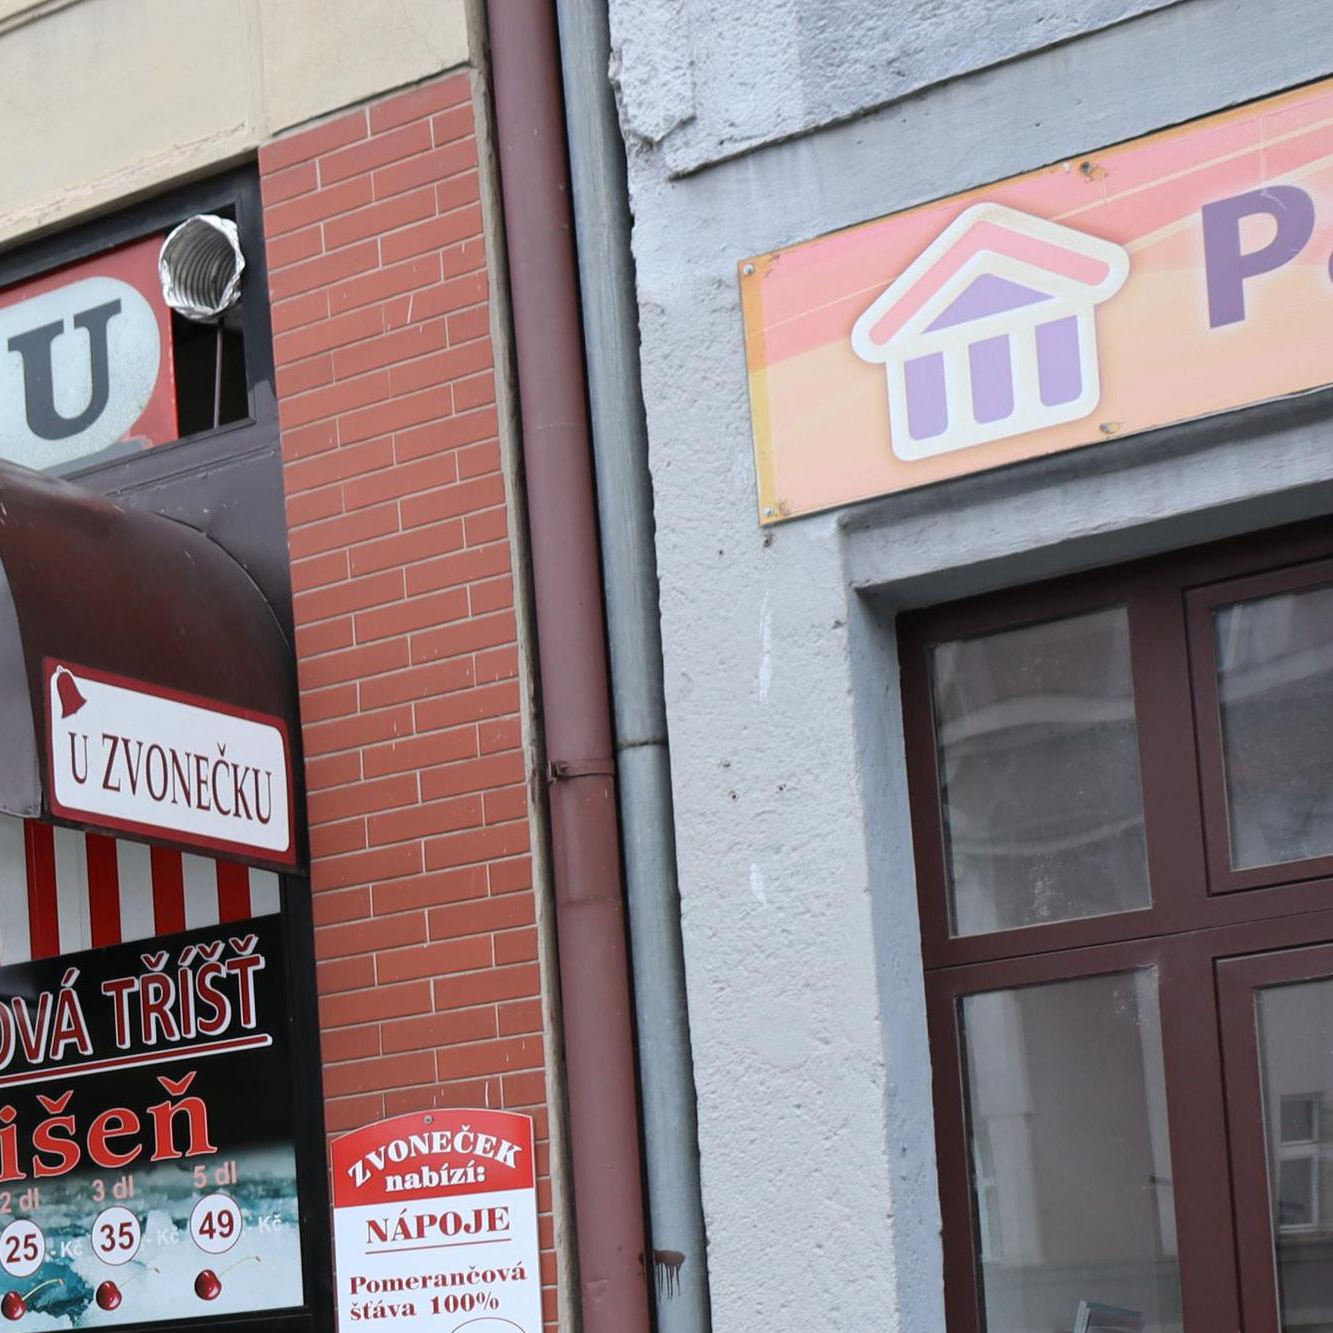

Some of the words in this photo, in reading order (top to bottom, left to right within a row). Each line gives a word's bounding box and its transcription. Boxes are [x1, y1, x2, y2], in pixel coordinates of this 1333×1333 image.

[68, 731, 89, 785] U
[101, 733, 273, 825] ZVONEČKU
[348, 1124, 523, 1188] ZVONEČEK
[92, 1180, 106, 1203] 3
[113, 1176, 135, 1199] dl
[193, 1165, 207, 1189] 5
[215, 1161, 237, 1186] dl
[385, 1160, 486, 1192] nabízí:
[0, 1193, 12, 1214] 2
[20, 1188, 40, 1211] dl
[366, 1206, 510, 1244] NÁPOJE
[350, 1260, 527, 1295] Pomerančová
[350, 1299, 416, 1321] šťáva
[431, 1291, 499, 1315] 100%
